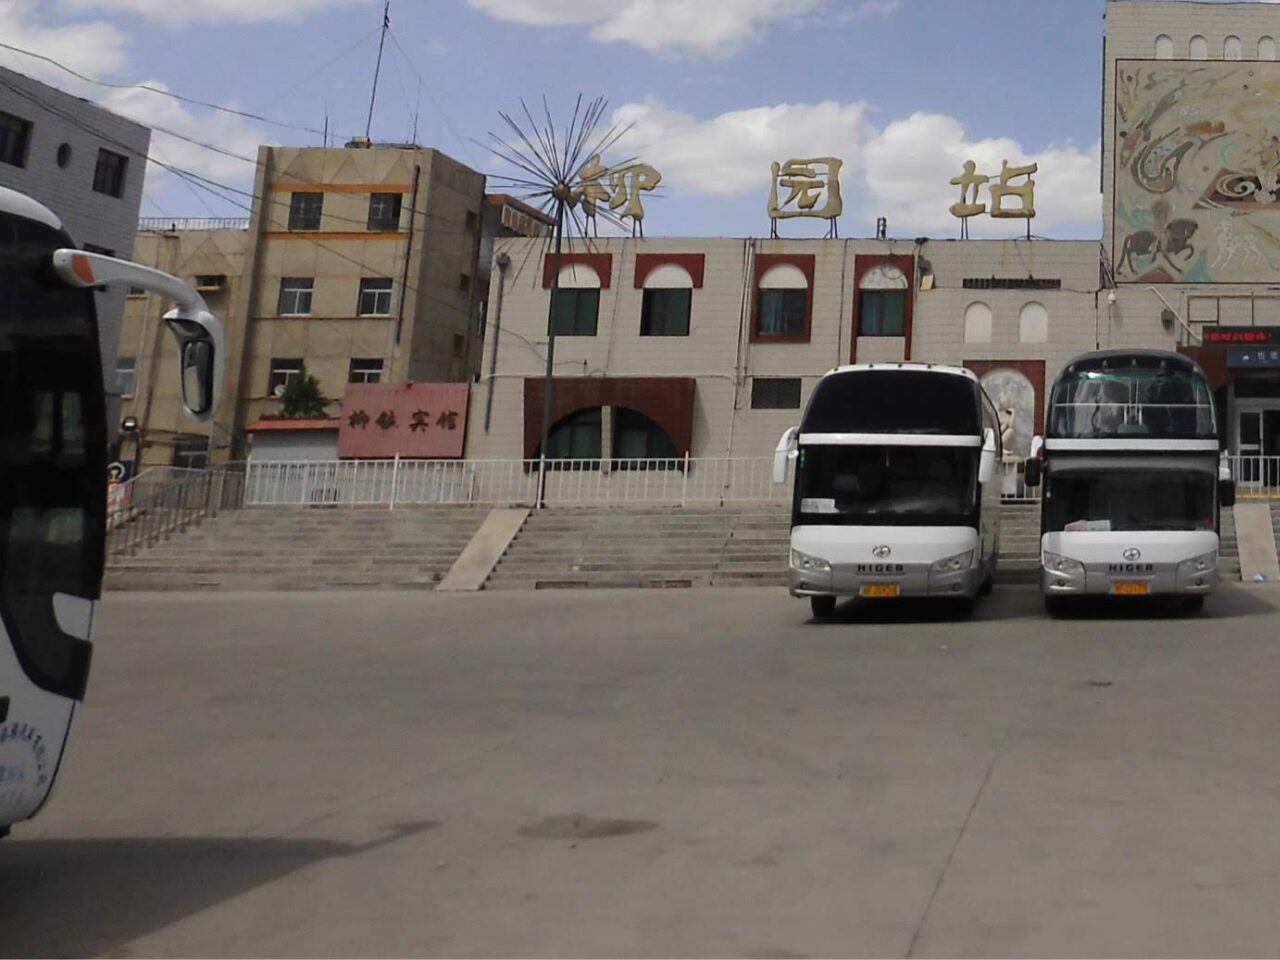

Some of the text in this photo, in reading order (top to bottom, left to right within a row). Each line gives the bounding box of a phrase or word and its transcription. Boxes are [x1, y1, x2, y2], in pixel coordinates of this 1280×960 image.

[568, 153, 1039, 221] 柳园站
[857, 562, 904, 573] HIGER
[1108, 562, 1153, 573] HIGER
